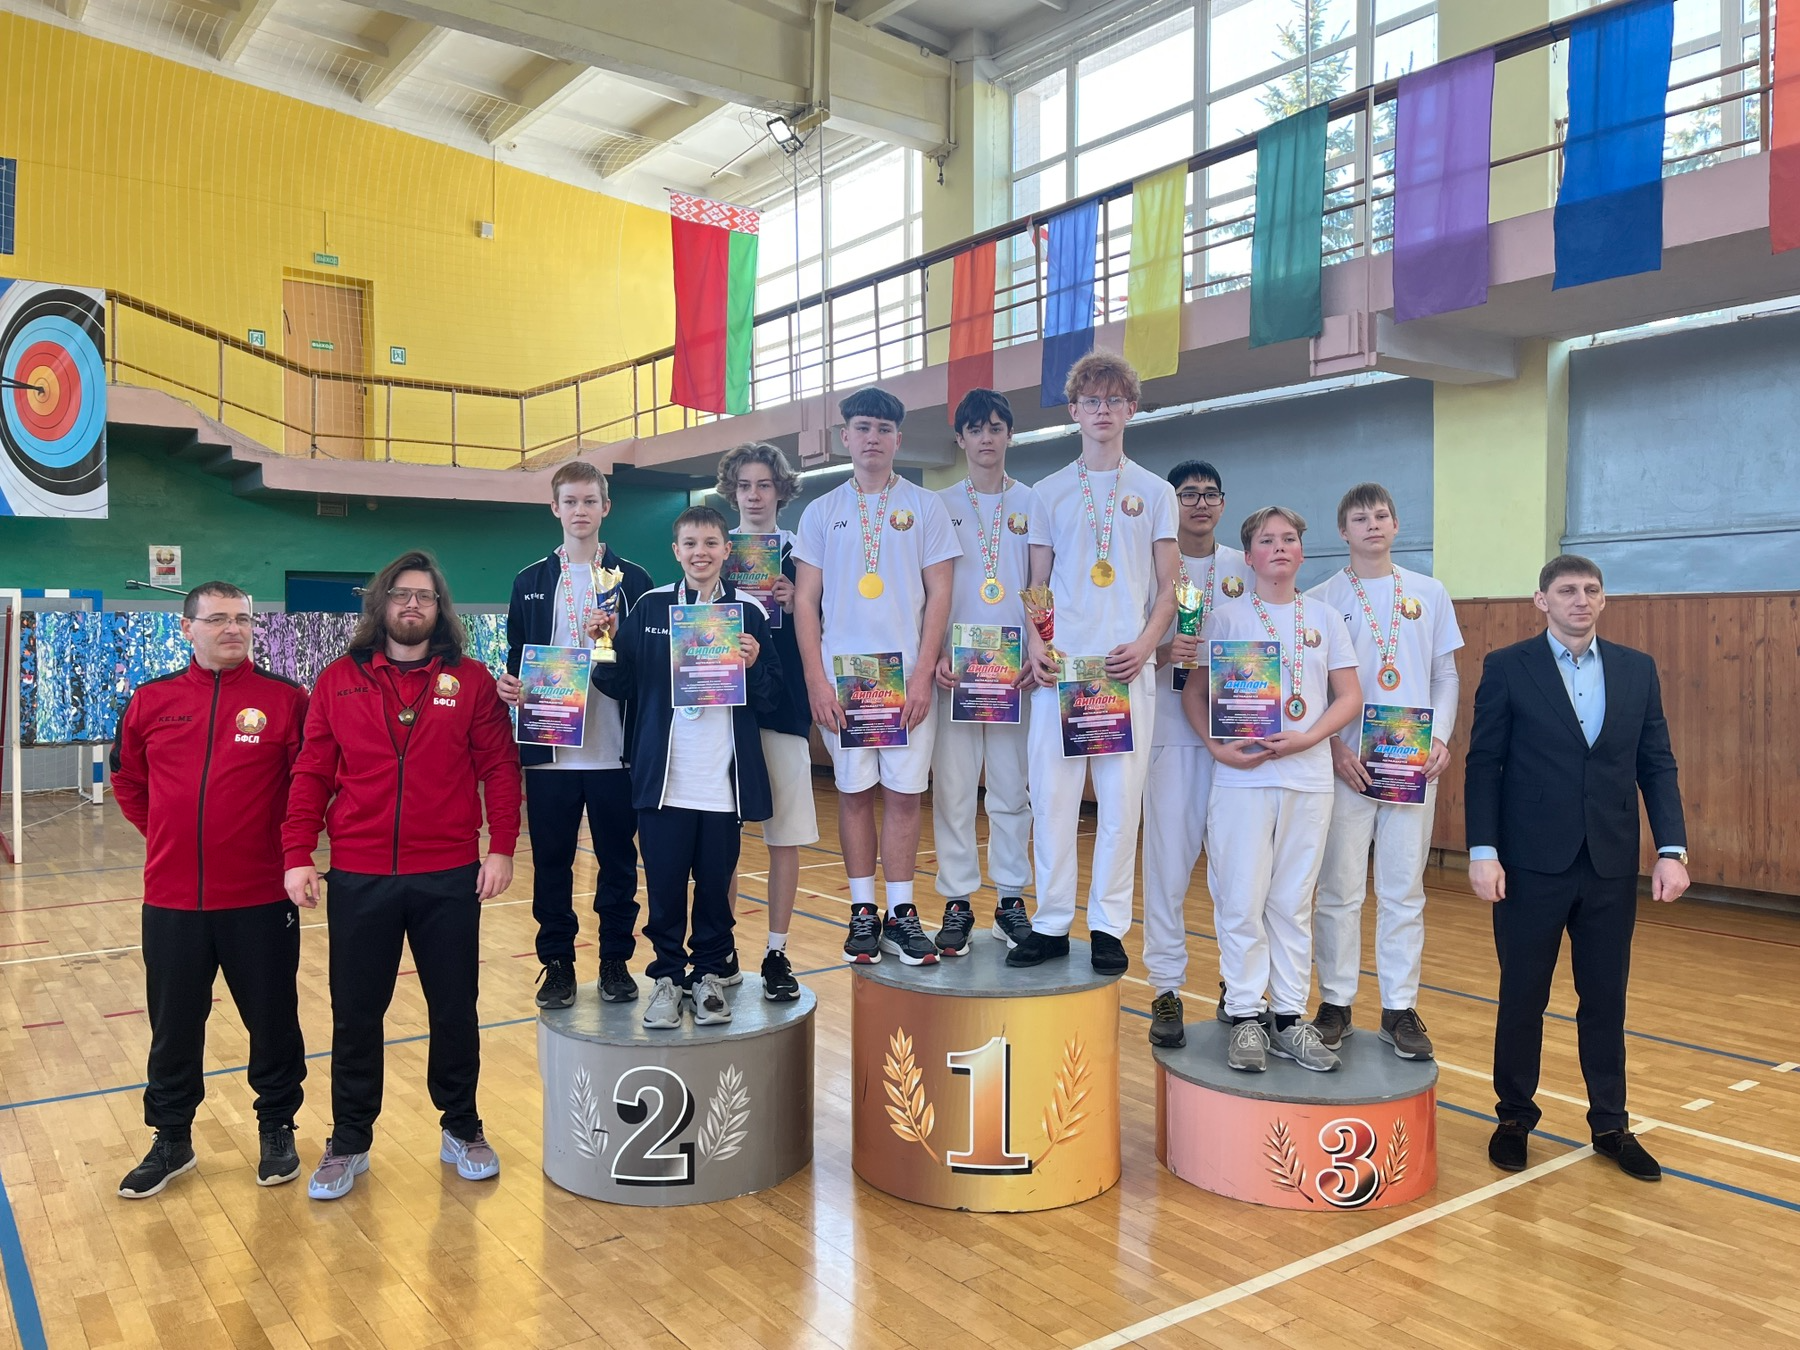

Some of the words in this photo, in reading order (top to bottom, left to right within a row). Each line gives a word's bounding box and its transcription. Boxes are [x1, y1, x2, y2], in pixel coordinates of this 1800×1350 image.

[728, 572, 768, 581] ДИПЛОМ
[645, 626, 671, 636] KELM
[686, 646, 730, 656] ДИПЛОМ
[967, 664, 1008, 673] ДИПЛОМ
[1224, 680, 1268, 690] ДИПЛОМ
[337, 686, 369, 696] KELME
[531, 686, 574, 696] ДИПЛОМ
[851, 690, 892, 700] ДИПЛОМ
[434, 697, 456, 708] БФСЛ
[1074, 696, 1117, 707] ДИПЛОМ
[234, 734, 260, 744] БФСЛ
[1374, 745, 1418, 754] ДИПЛОМ
[945, 1036, 1033, 1174] 1
[610, 1066, 694, 1186] 2
[1315, 1117, 1380, 1208] 3
